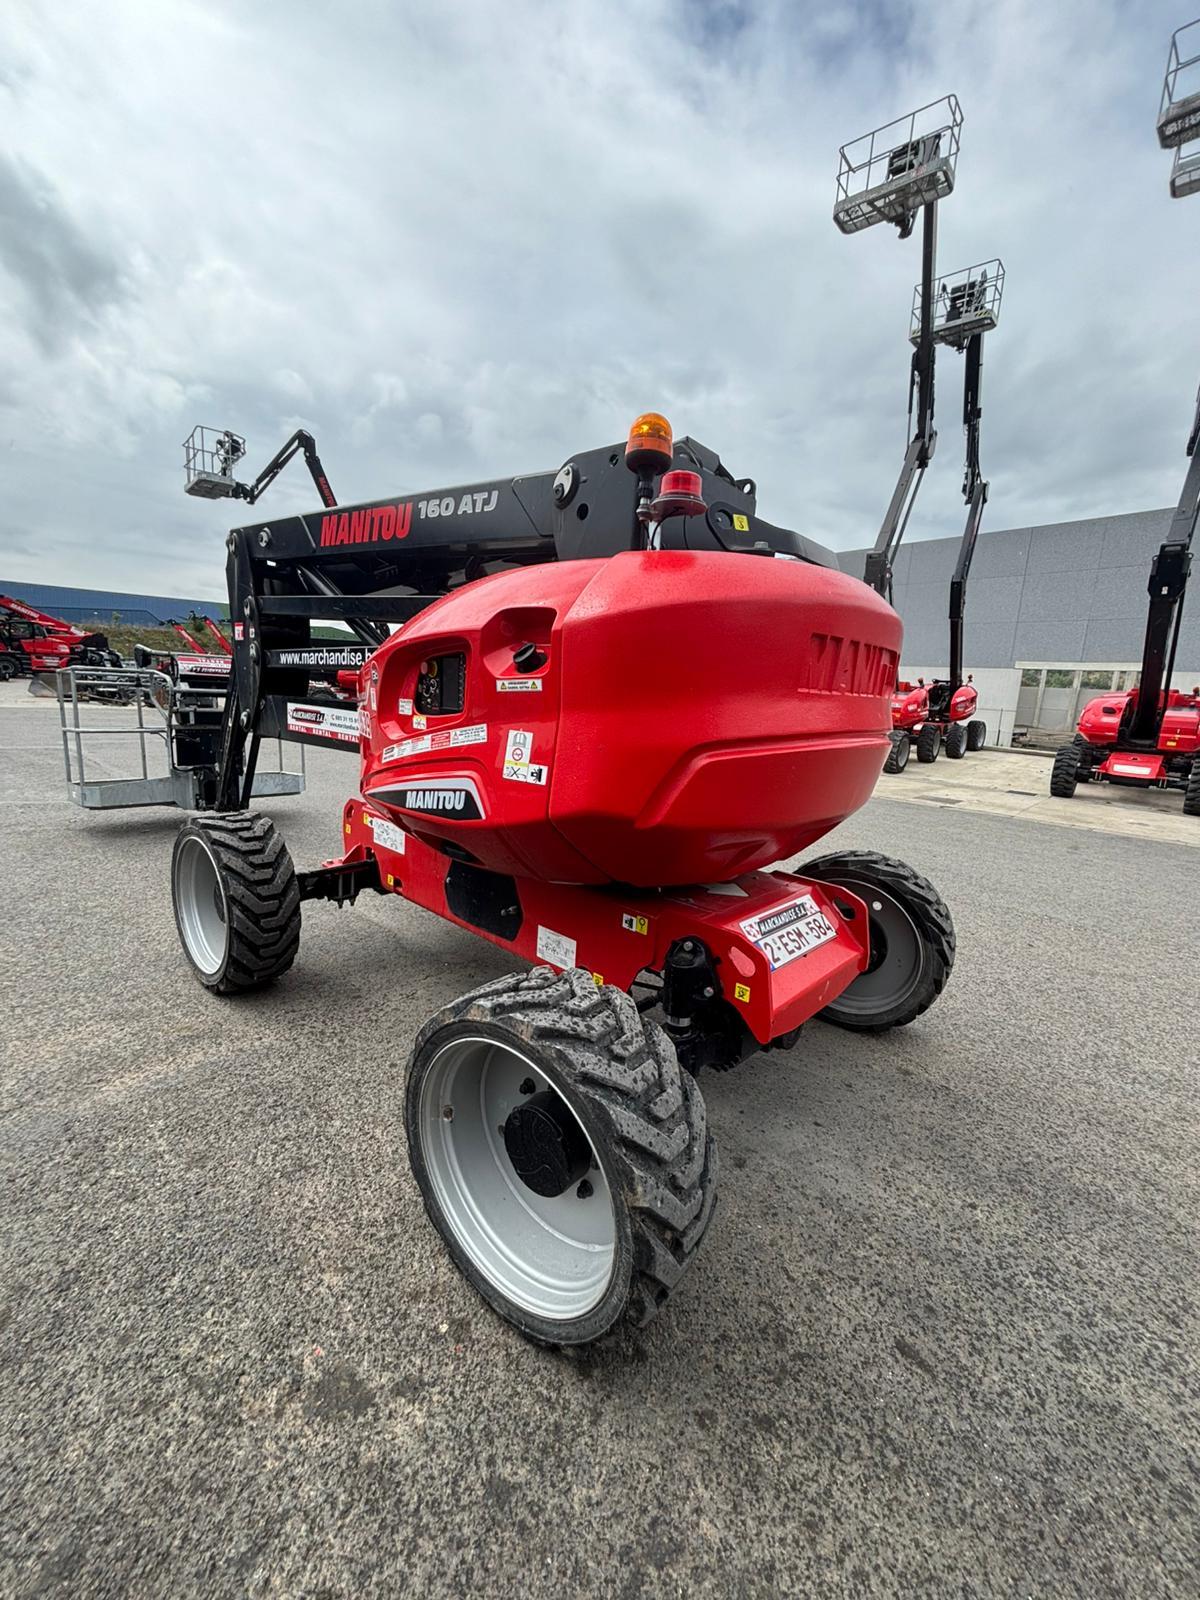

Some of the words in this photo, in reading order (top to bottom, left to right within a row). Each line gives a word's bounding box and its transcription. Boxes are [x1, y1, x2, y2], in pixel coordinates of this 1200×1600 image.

[320, 502, 412, 547] MANITOU
[418, 497, 455, 519] 160
[457, 490, 499, 515] ATJ
[289, 724, 307, 733] RENTAL
[312, 728, 332, 738] RENTAL
[337, 733, 359, 743] RENTAL
[405, 790, 466, 811] MANITOU
[760, 910, 796, 934] MARCHANDISE
[763, 915, 834, 963] 2-ESM-584
